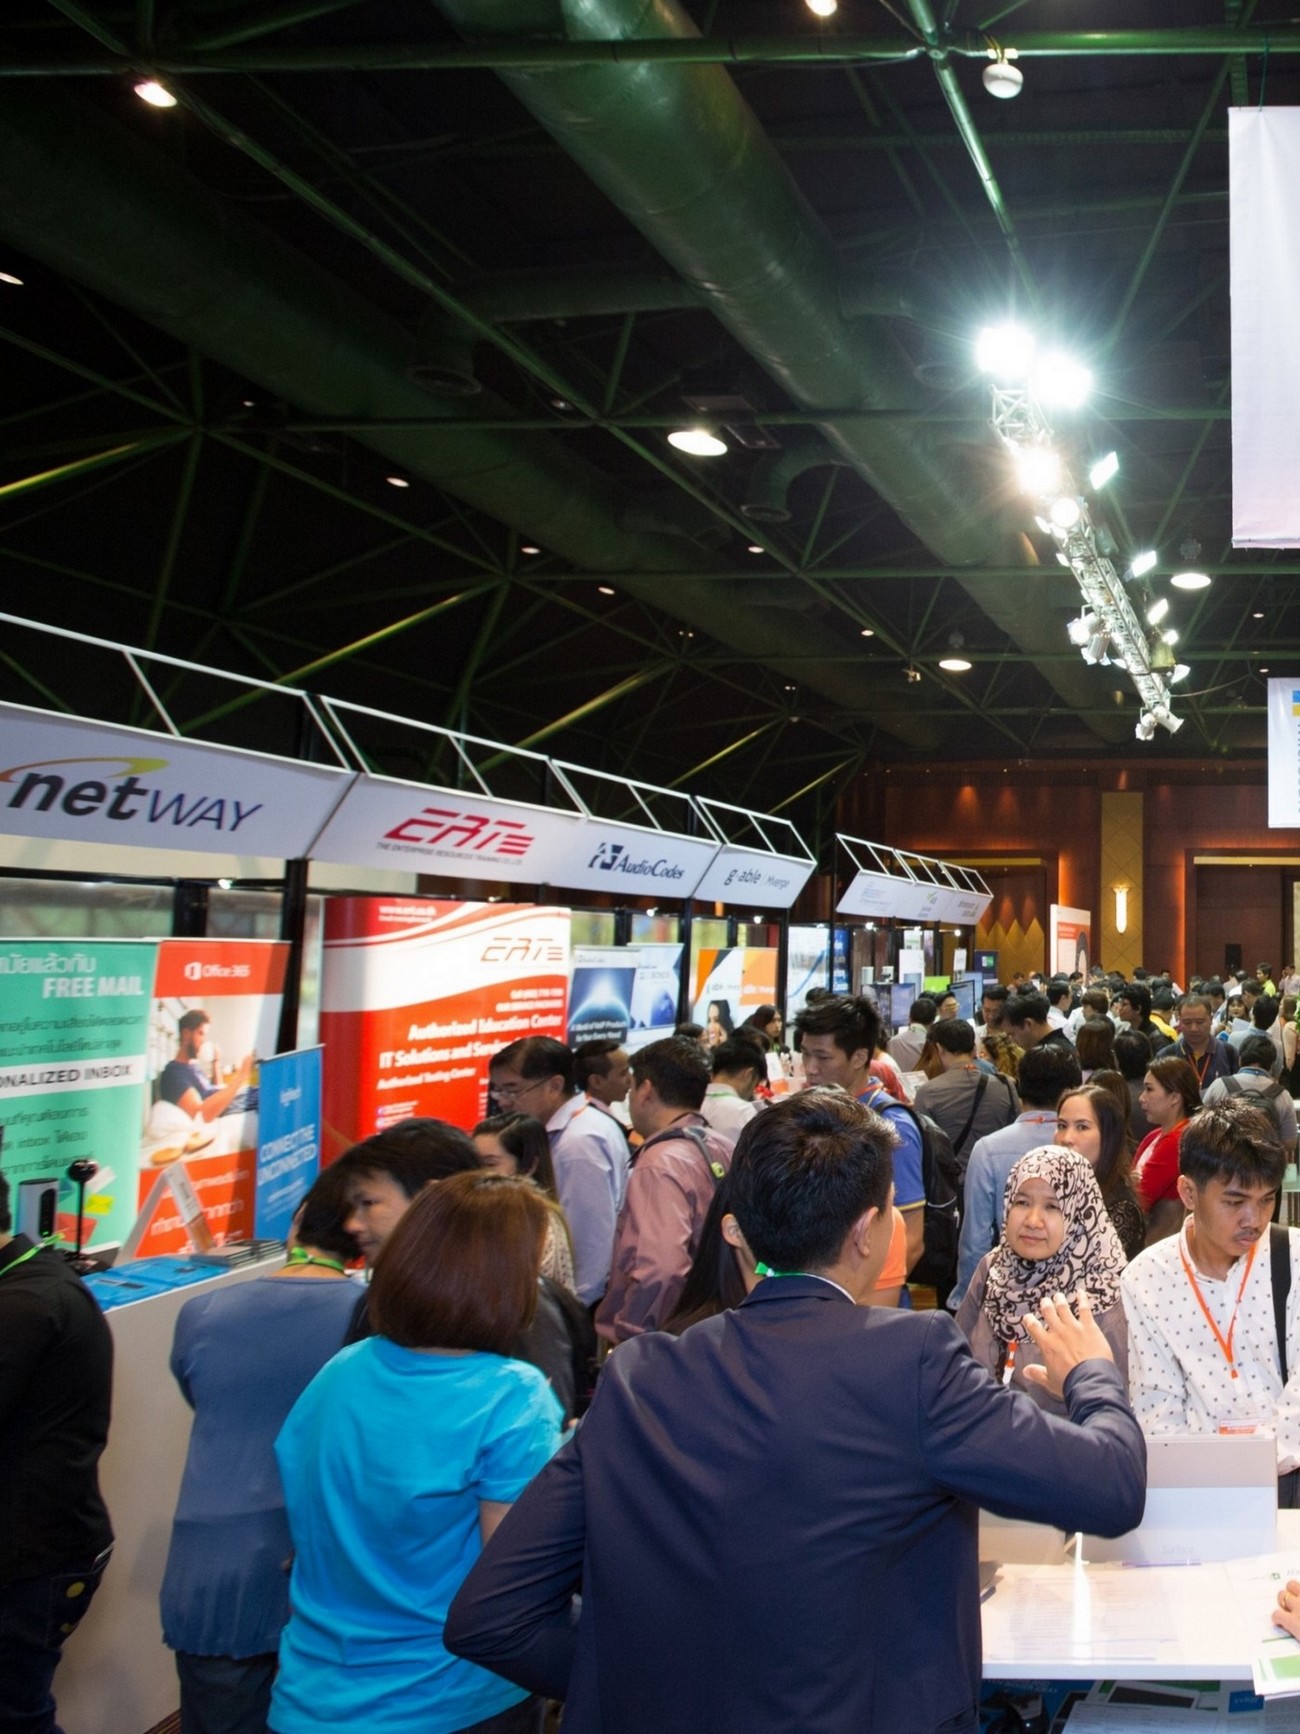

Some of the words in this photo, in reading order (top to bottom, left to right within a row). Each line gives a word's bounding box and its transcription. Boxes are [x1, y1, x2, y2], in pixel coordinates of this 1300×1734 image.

[612, 854, 685, 880] AudioCodes
[42, 976, 95, 998] FREE
[96, 975, 144, 996] MAIL
[407, 1019, 477, 1041] Authorized
[478, 1016, 530, 1034] Education
[530, 1014, 563, 1029] Center
[379, 1051, 394, 1069] IT
[394, 1046, 450, 1068] Solutions
[450, 1041, 473, 1061] and
[84, 1064, 133, 1081] INBOX
